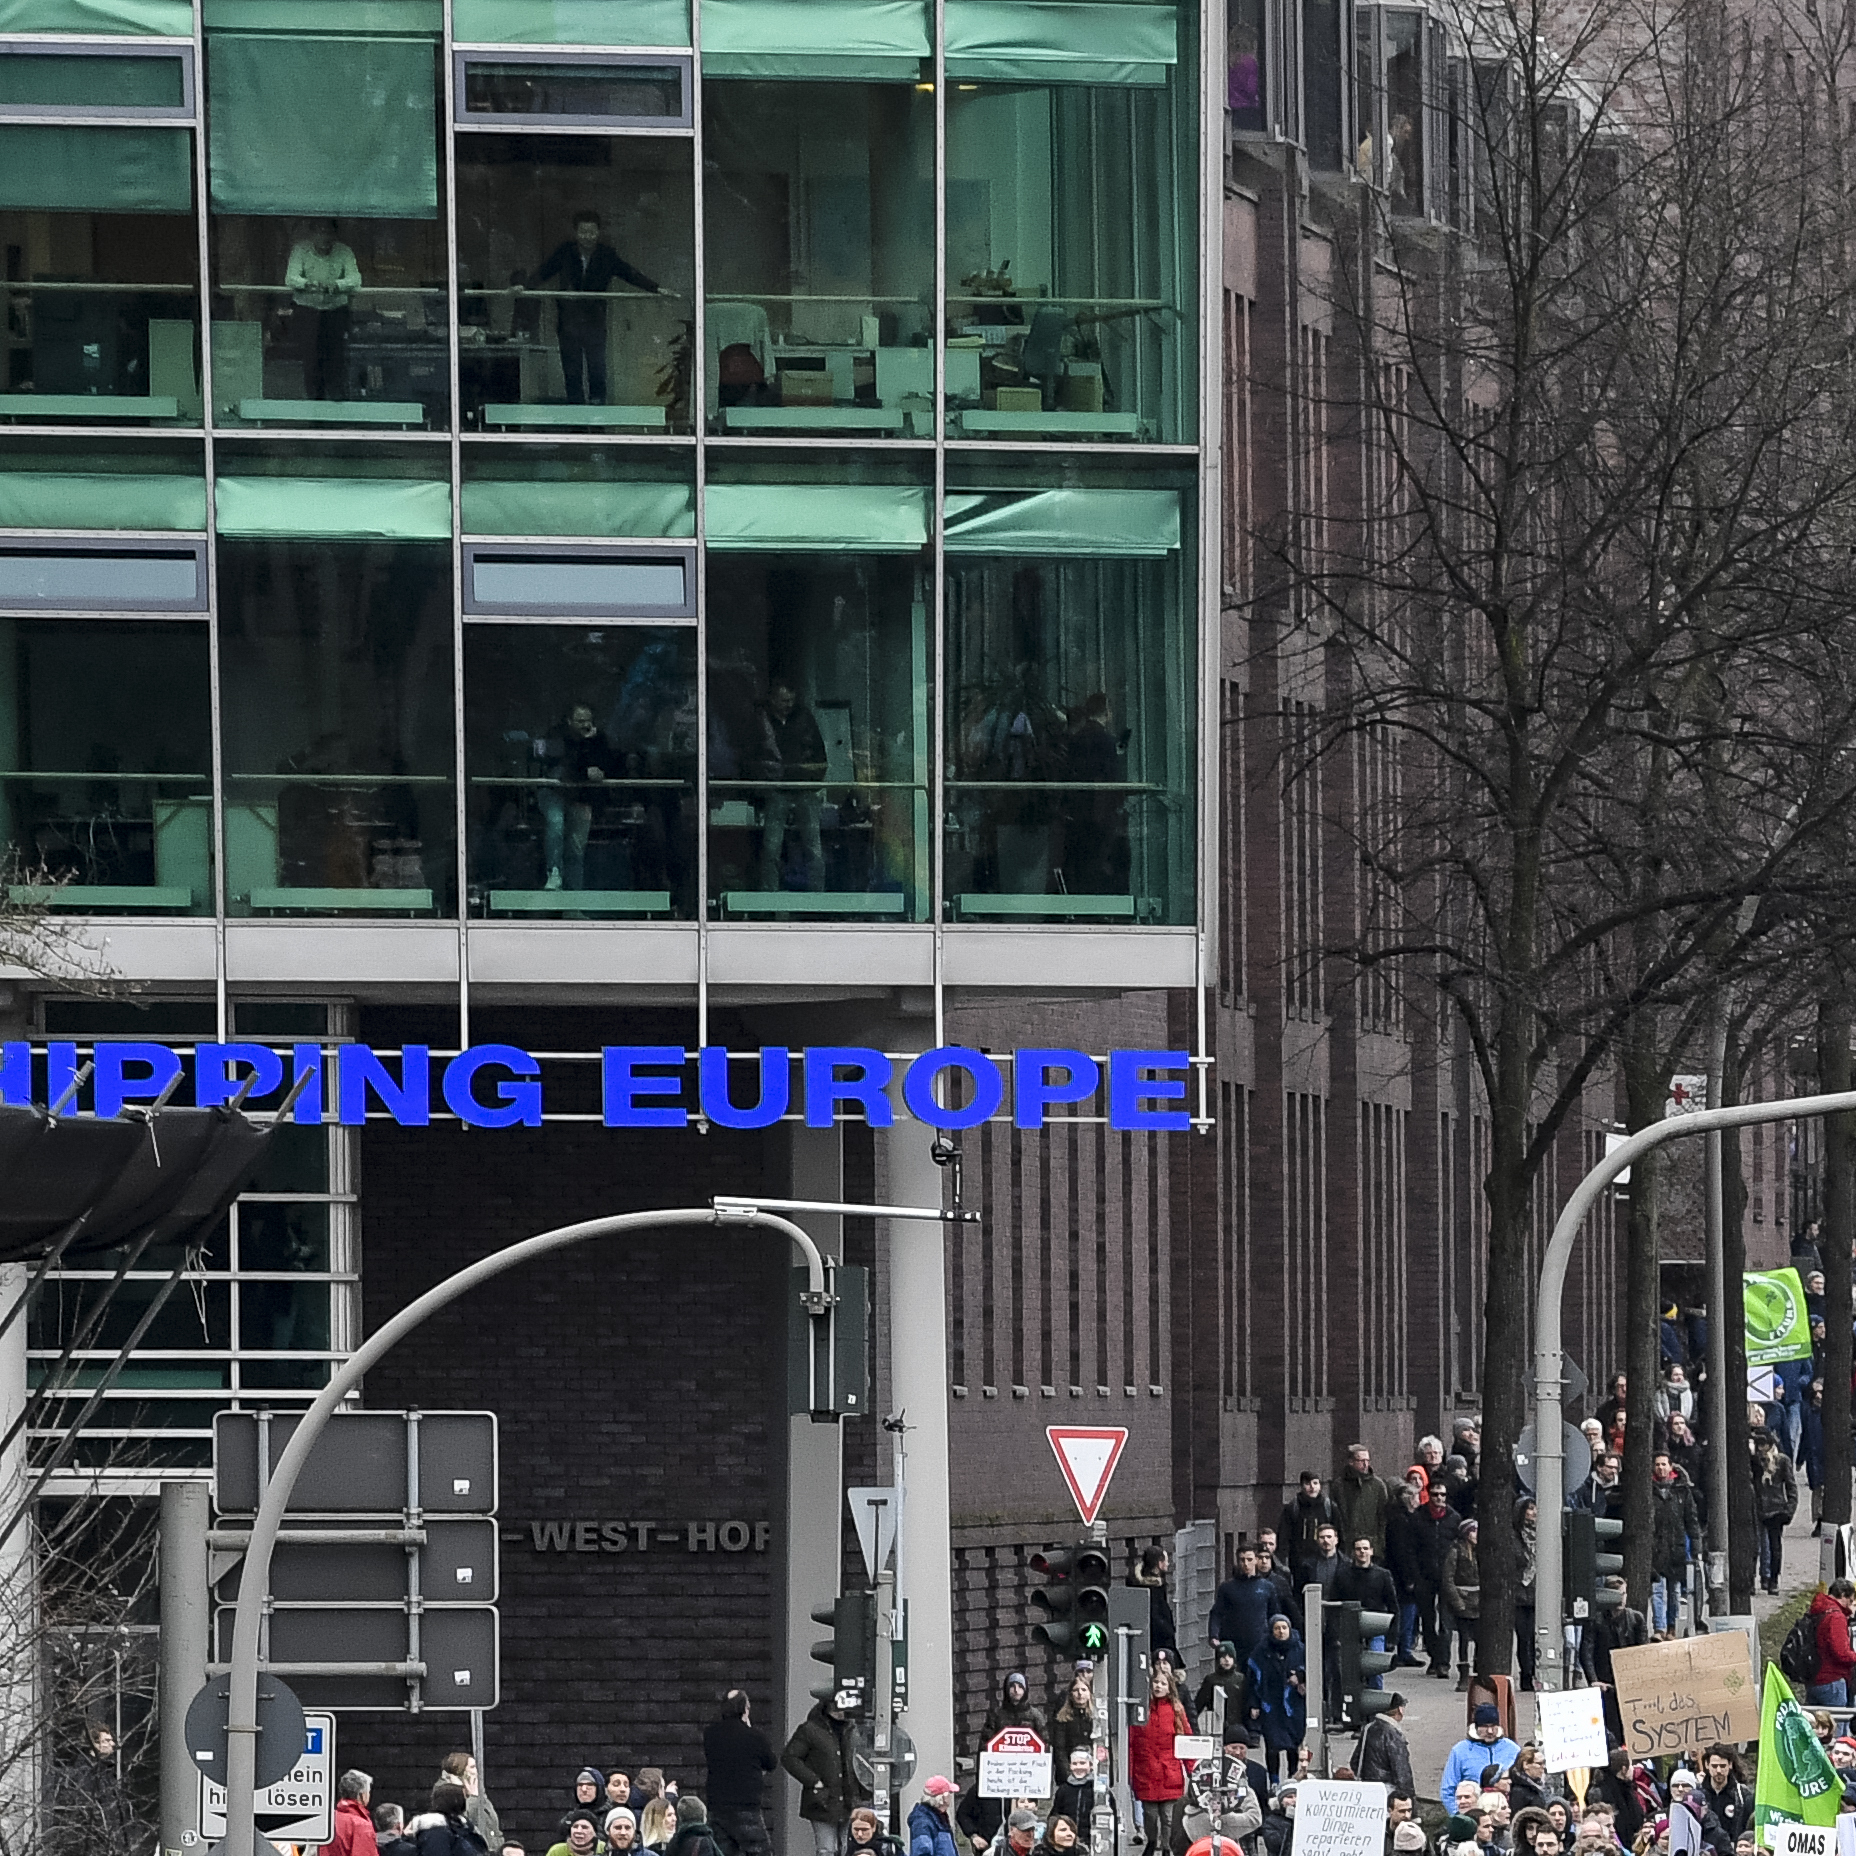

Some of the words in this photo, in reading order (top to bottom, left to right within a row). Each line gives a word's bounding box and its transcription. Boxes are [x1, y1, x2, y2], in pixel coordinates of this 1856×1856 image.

[604, 1045, 1190, 1131] EUROPE
[1003, 1733, 1031, 1746] STOP
[1631, 1710, 1731, 1756] SYSTEM
[267, 1786, 323, 1807] lösen
[1318, 1789, 1362, 1807] Wenig
[1305, 1803, 1384, 1821] konsumieren
[1321, 1817, 1356, 1835] Dinge
[1305, 1831, 1372, 1851] reparieren
[1786, 1832, 1826, 1856] OMAS
